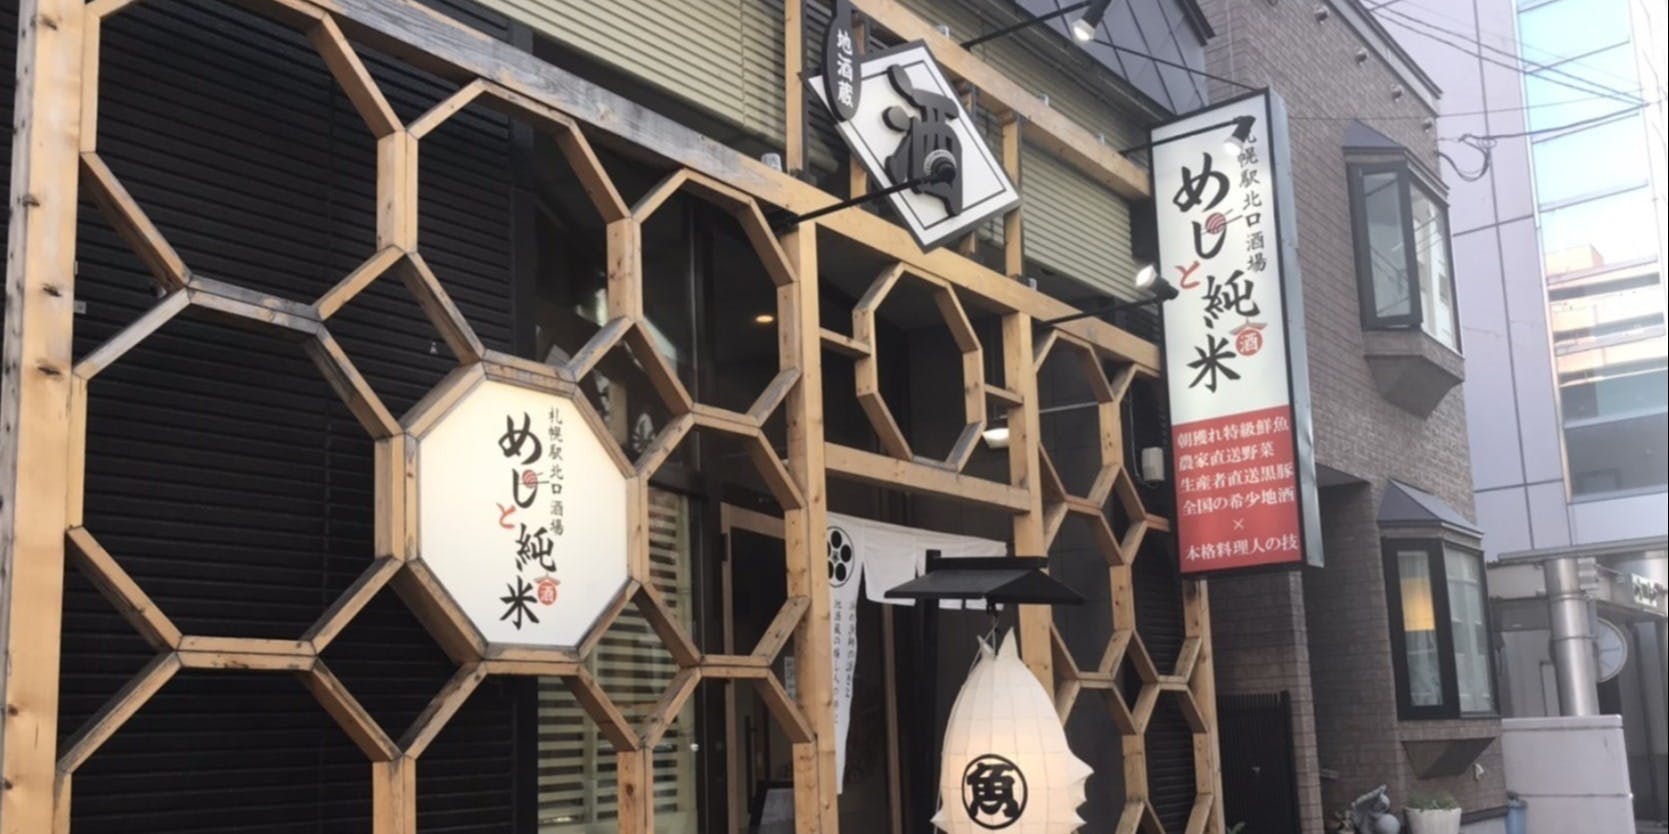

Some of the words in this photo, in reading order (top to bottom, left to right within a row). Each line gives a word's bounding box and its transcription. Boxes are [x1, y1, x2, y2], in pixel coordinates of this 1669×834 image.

[837, 28, 854, 108] 地酒蔵
[882, 64, 964, 217] 酒
[1172, 152, 1261, 394] めしと純米
[1239, 333, 1260, 353] 酒
[548, 406, 564, 536] 札幌駅北口酒場
[1179, 441, 1275, 471] 農家直送野菜
[1180, 463, 1294, 493] 生産者直送黒豚
[496, 411, 557, 631] めしと純米
[1183, 487, 1295, 516] 全国の希少地酒
[1186, 534, 1299, 562] 本格料理人の技
[965, 761, 1020, 819] 魚
